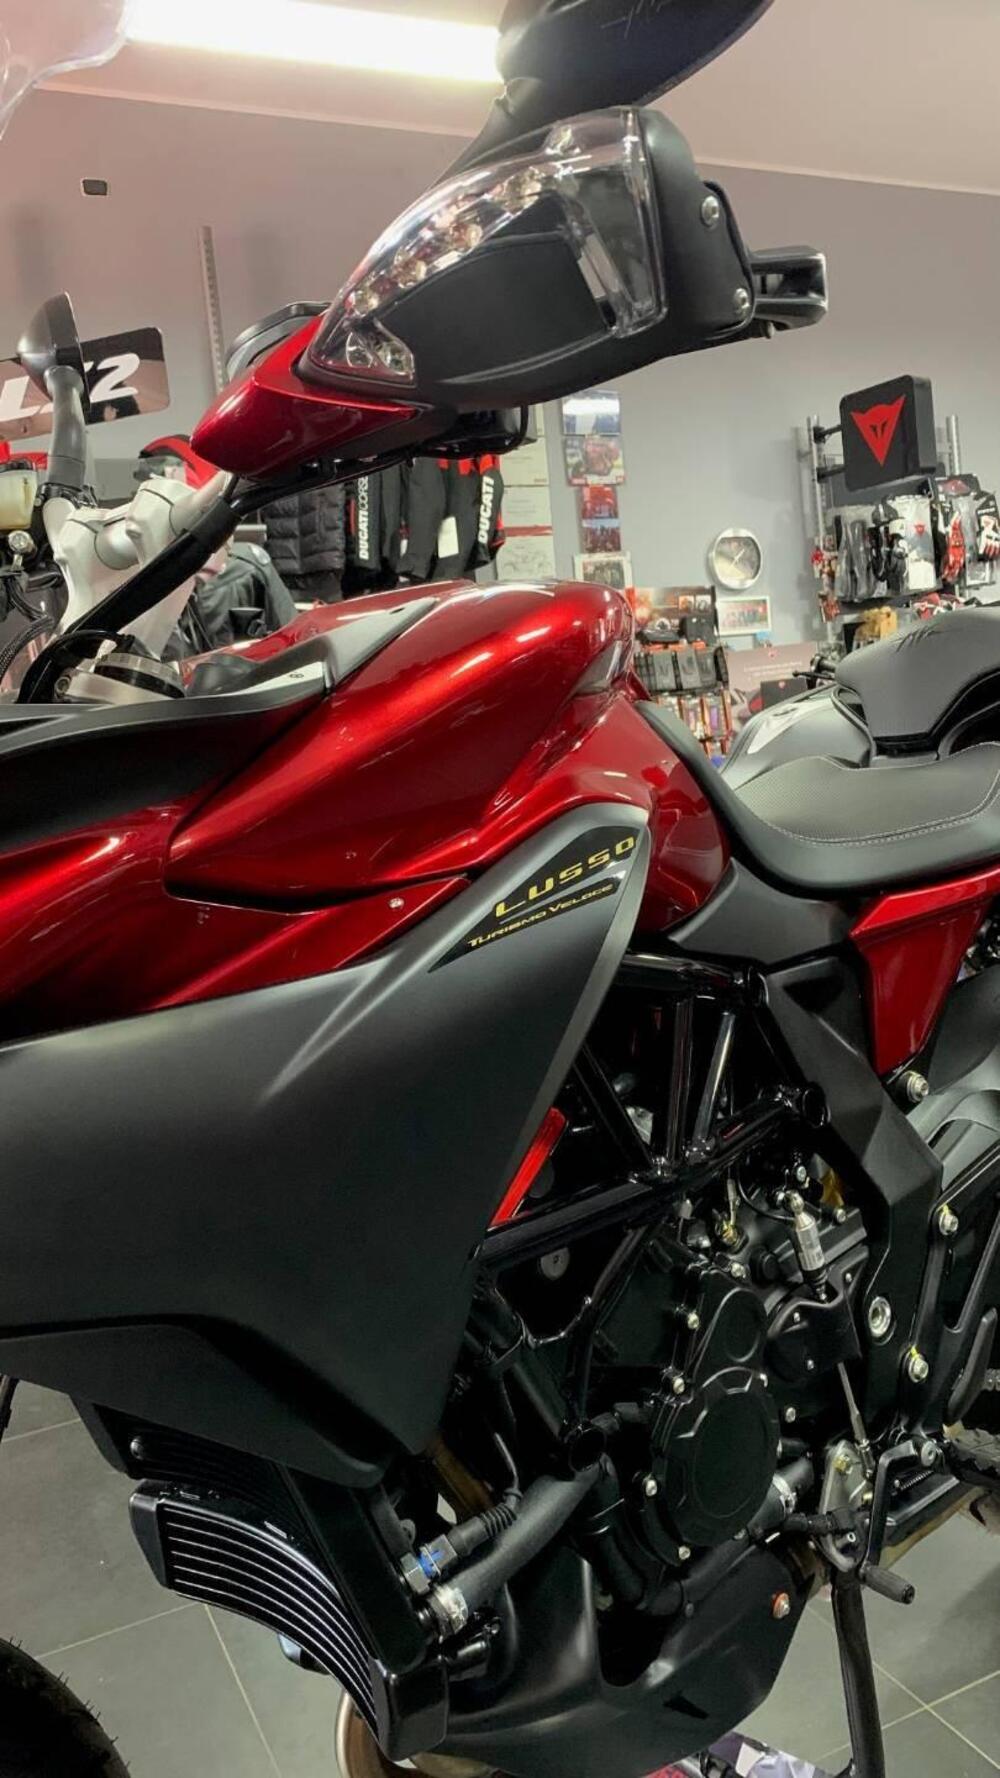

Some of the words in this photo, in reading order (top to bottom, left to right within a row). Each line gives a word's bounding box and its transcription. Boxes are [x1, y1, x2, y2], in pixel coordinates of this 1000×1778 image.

[0, 353, 140, 421] L2
[478, 475, 495, 544] DUCATI
[495, 836, 635, 918] LUSSO
[467, 910, 547, 947] TURISMO
[549, 884, 613, 913] VELOCE
